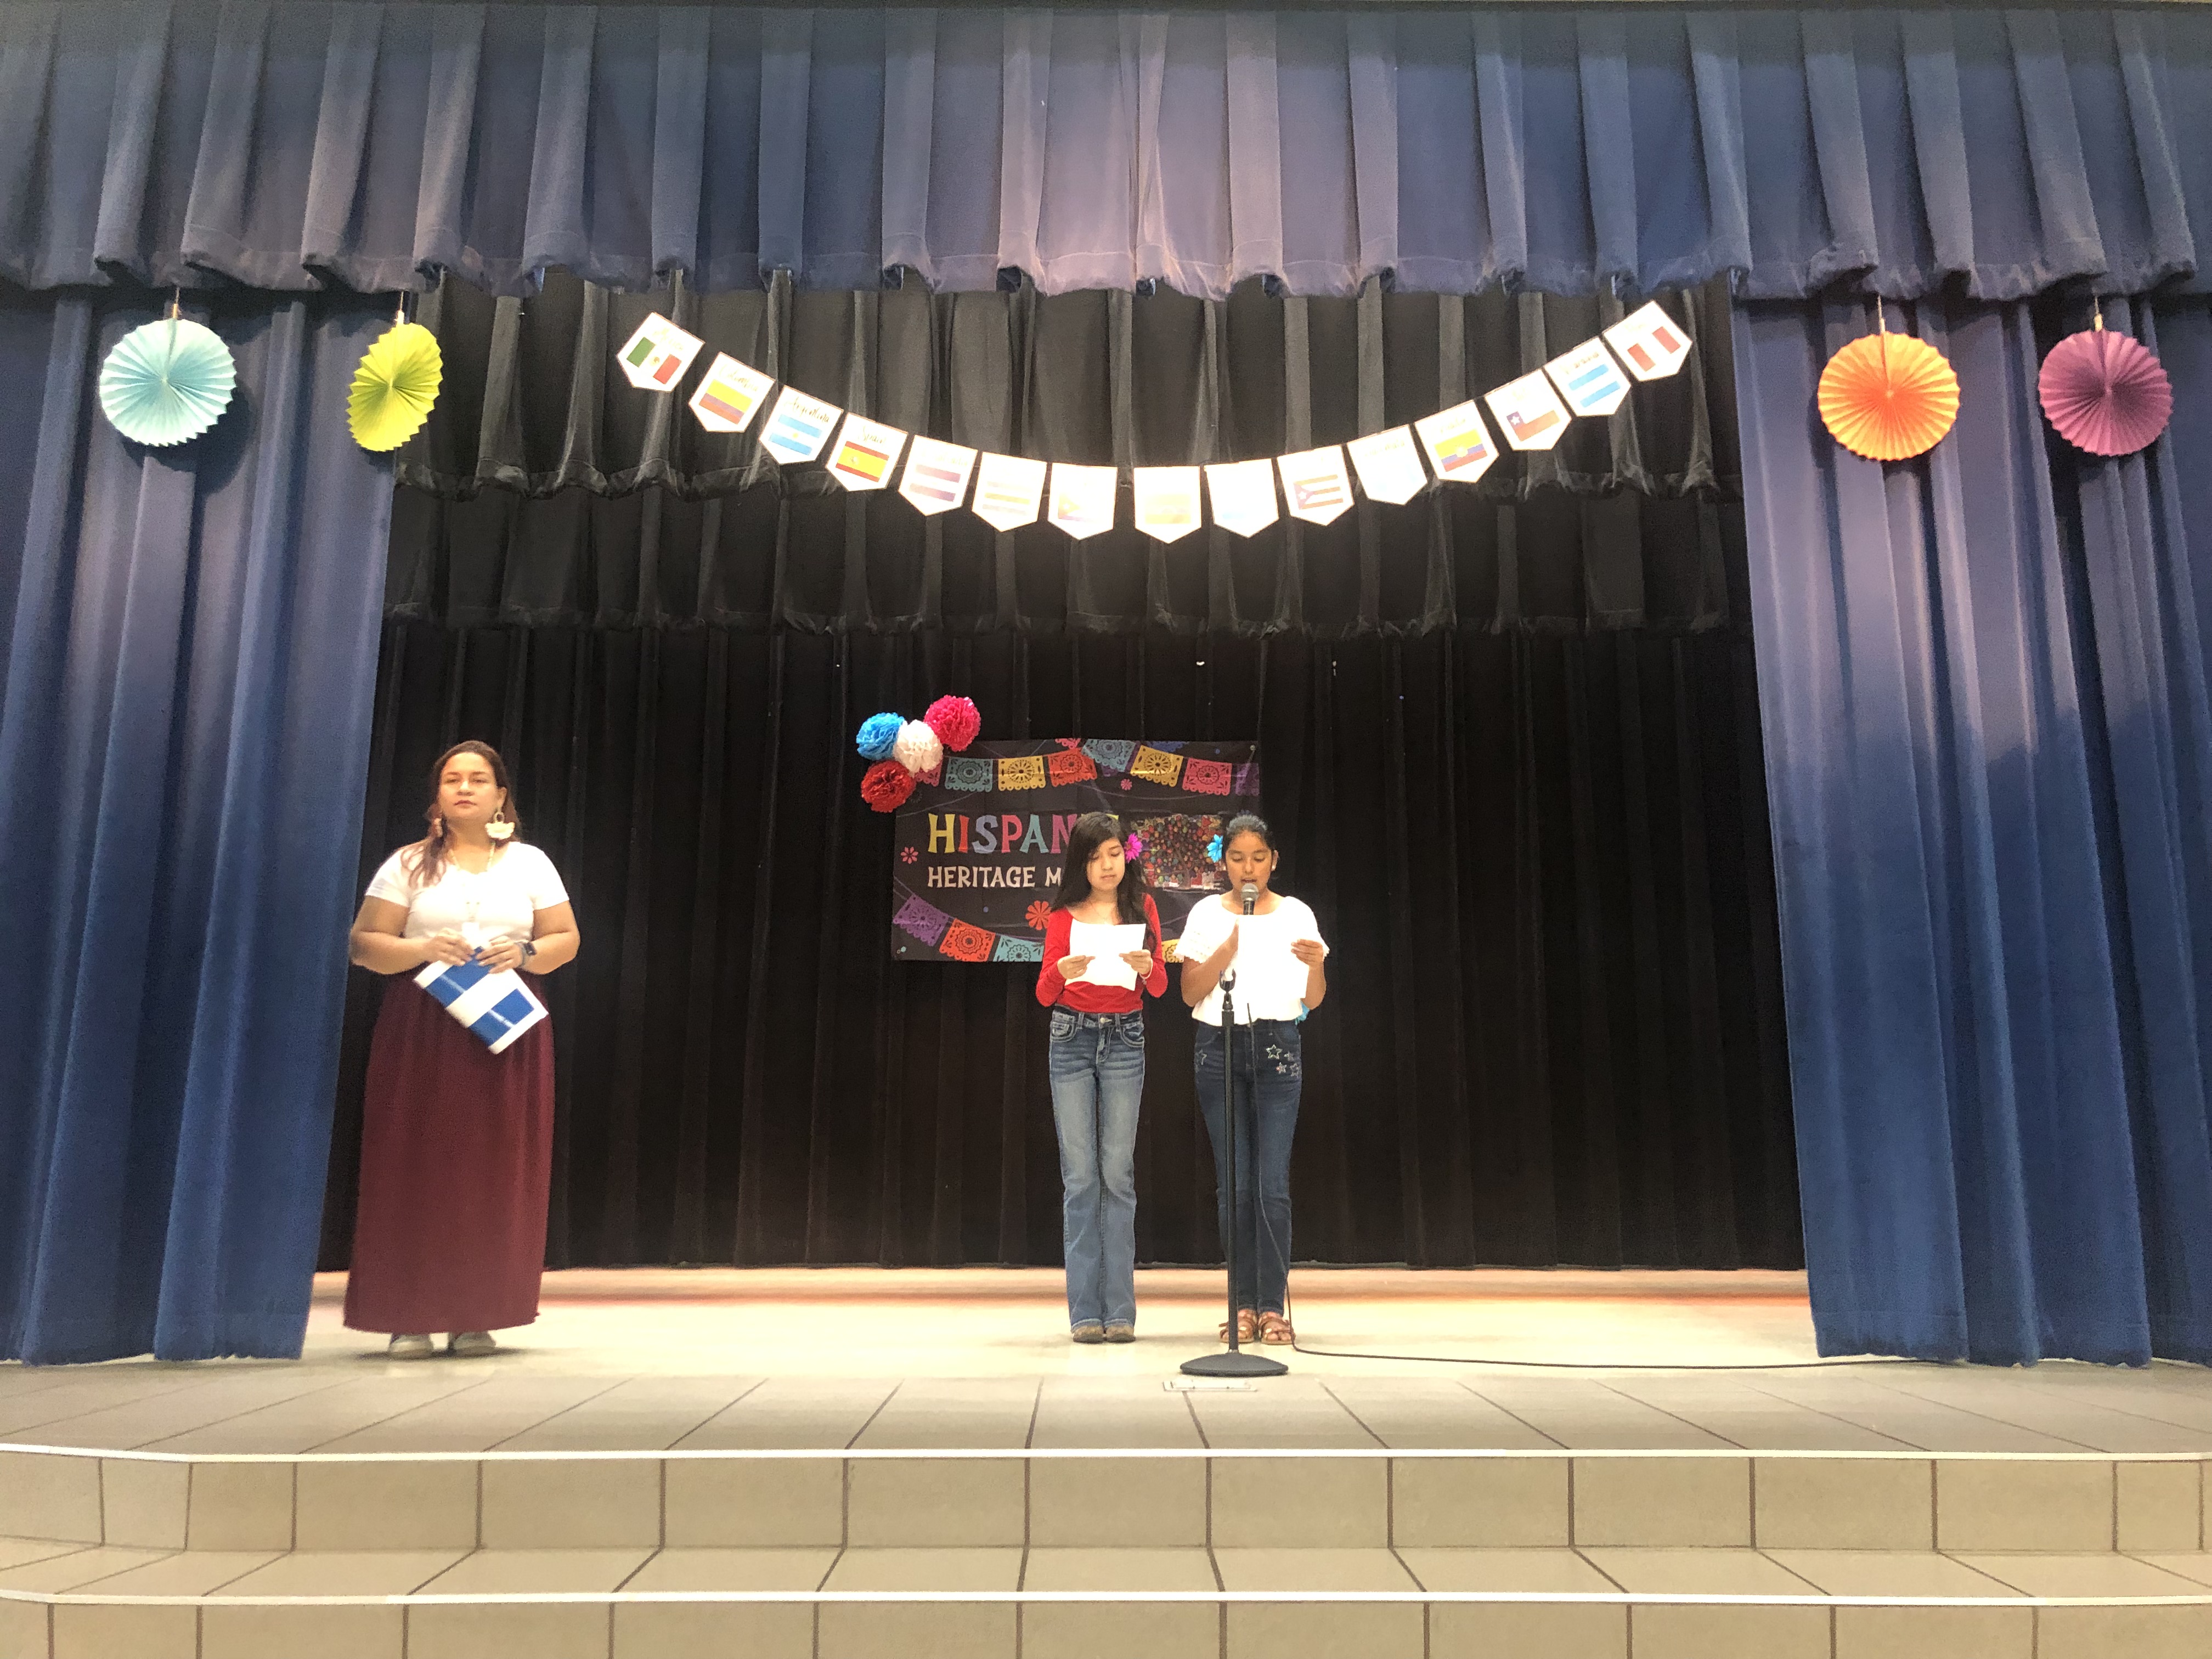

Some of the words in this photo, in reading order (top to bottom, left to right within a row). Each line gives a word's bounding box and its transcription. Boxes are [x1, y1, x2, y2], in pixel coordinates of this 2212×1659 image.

[783, 396, 831, 425] Argentina
[857, 425, 888, 445] Spain
[928, 812, 1119, 854] HISPAN
[927, 866, 1036, 888] HERITAGE
